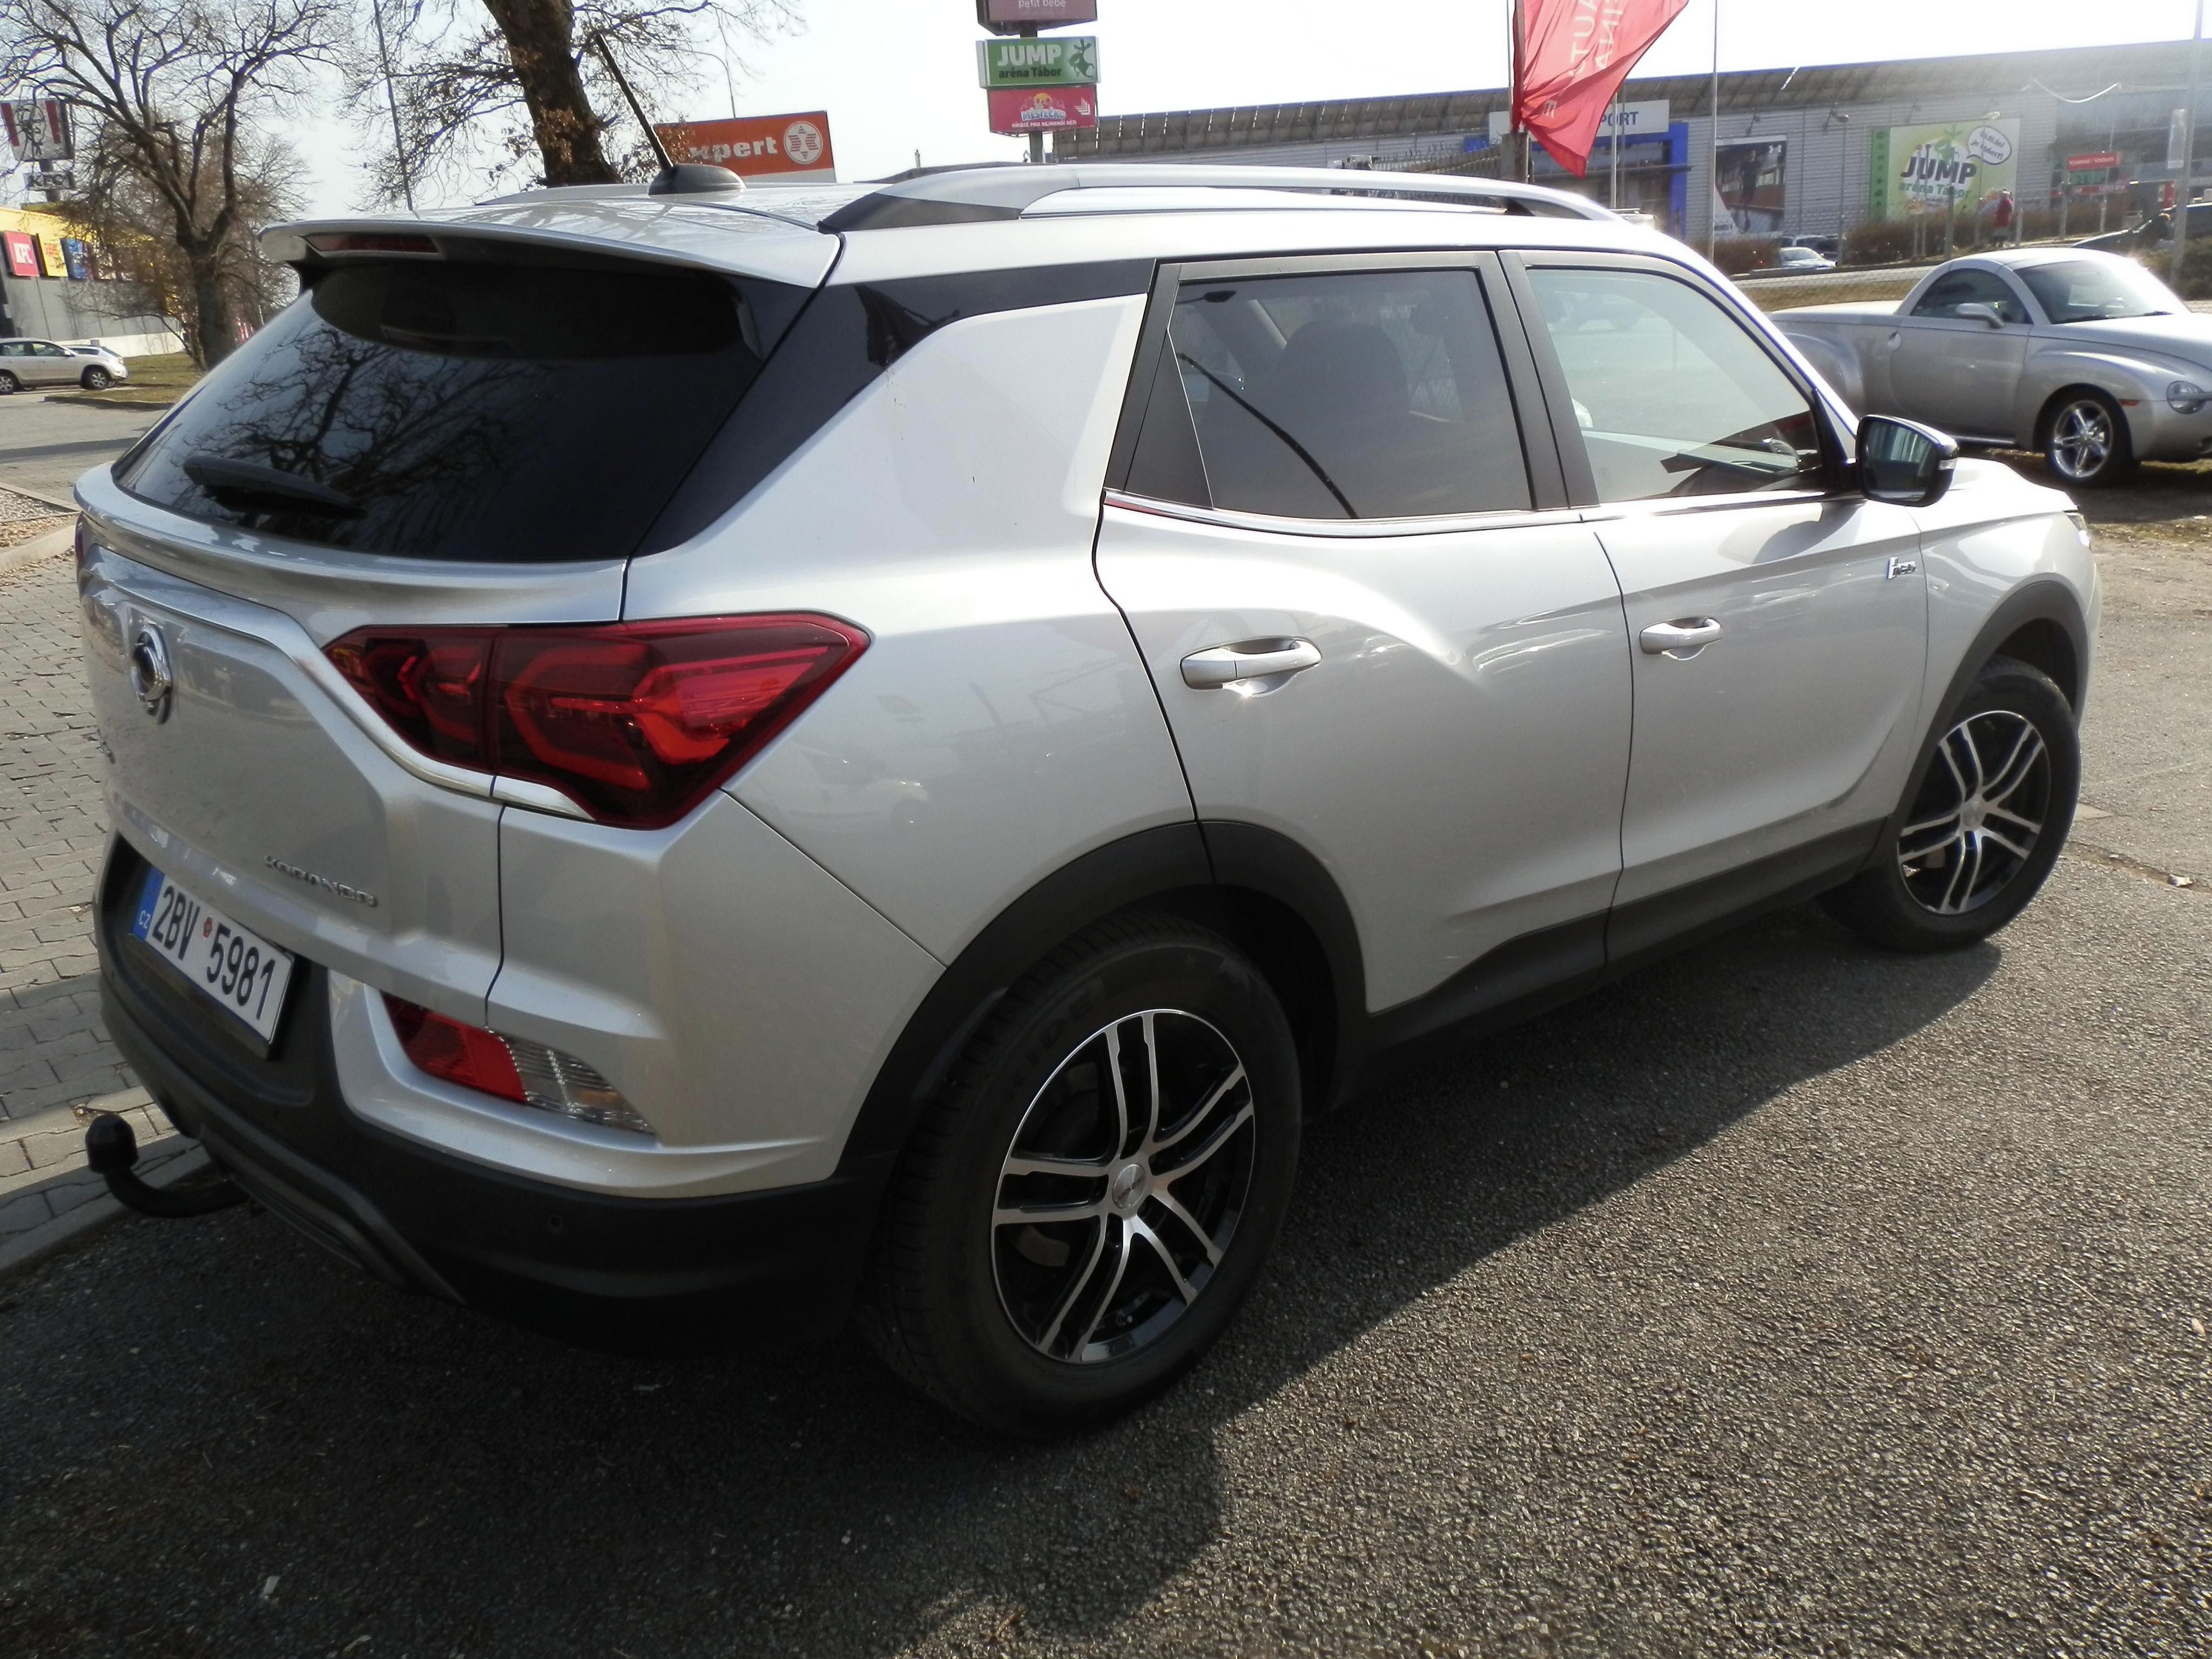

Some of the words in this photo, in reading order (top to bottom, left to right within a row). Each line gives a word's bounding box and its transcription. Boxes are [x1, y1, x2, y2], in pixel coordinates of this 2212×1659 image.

[997, 44, 1062, 66] JUMP
[999, 66, 1029, 78] aréna
[1031, 66, 1062, 77] Tábor
[687, 137, 778, 163] xpert
[1900, 156, 1977, 184] JUMP
[138, 910, 151, 929] CZ
[152, 886, 200, 961] 2BV
[207, 922, 275, 1020] 5981
